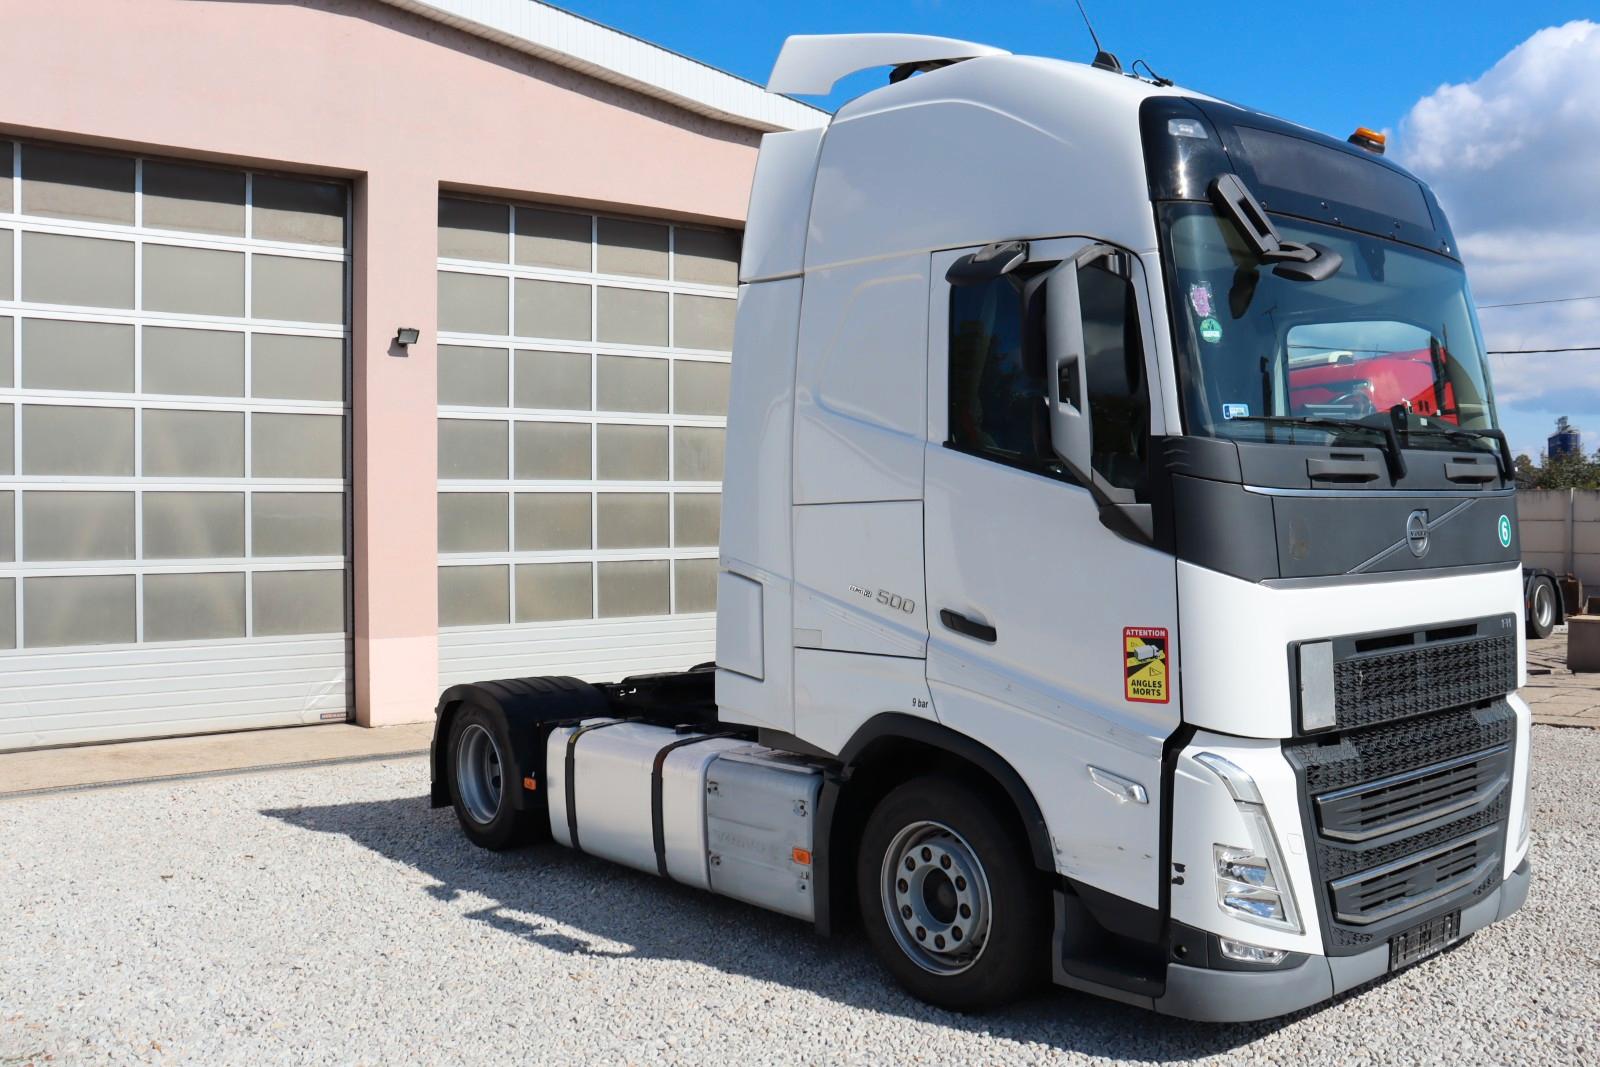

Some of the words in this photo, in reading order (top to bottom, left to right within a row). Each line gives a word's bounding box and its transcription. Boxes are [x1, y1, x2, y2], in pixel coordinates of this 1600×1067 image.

[1501, 521, 1509, 541] 6
[876, 588, 915, 615] 500
[1126, 629, 1166, 637] ATTENTION
[1131, 679, 1162, 689] ANGLES
[1132, 687, 1161, 697] MORTS
[912, 697, 917, 707] 9
[917, 698, 929, 709] bar
